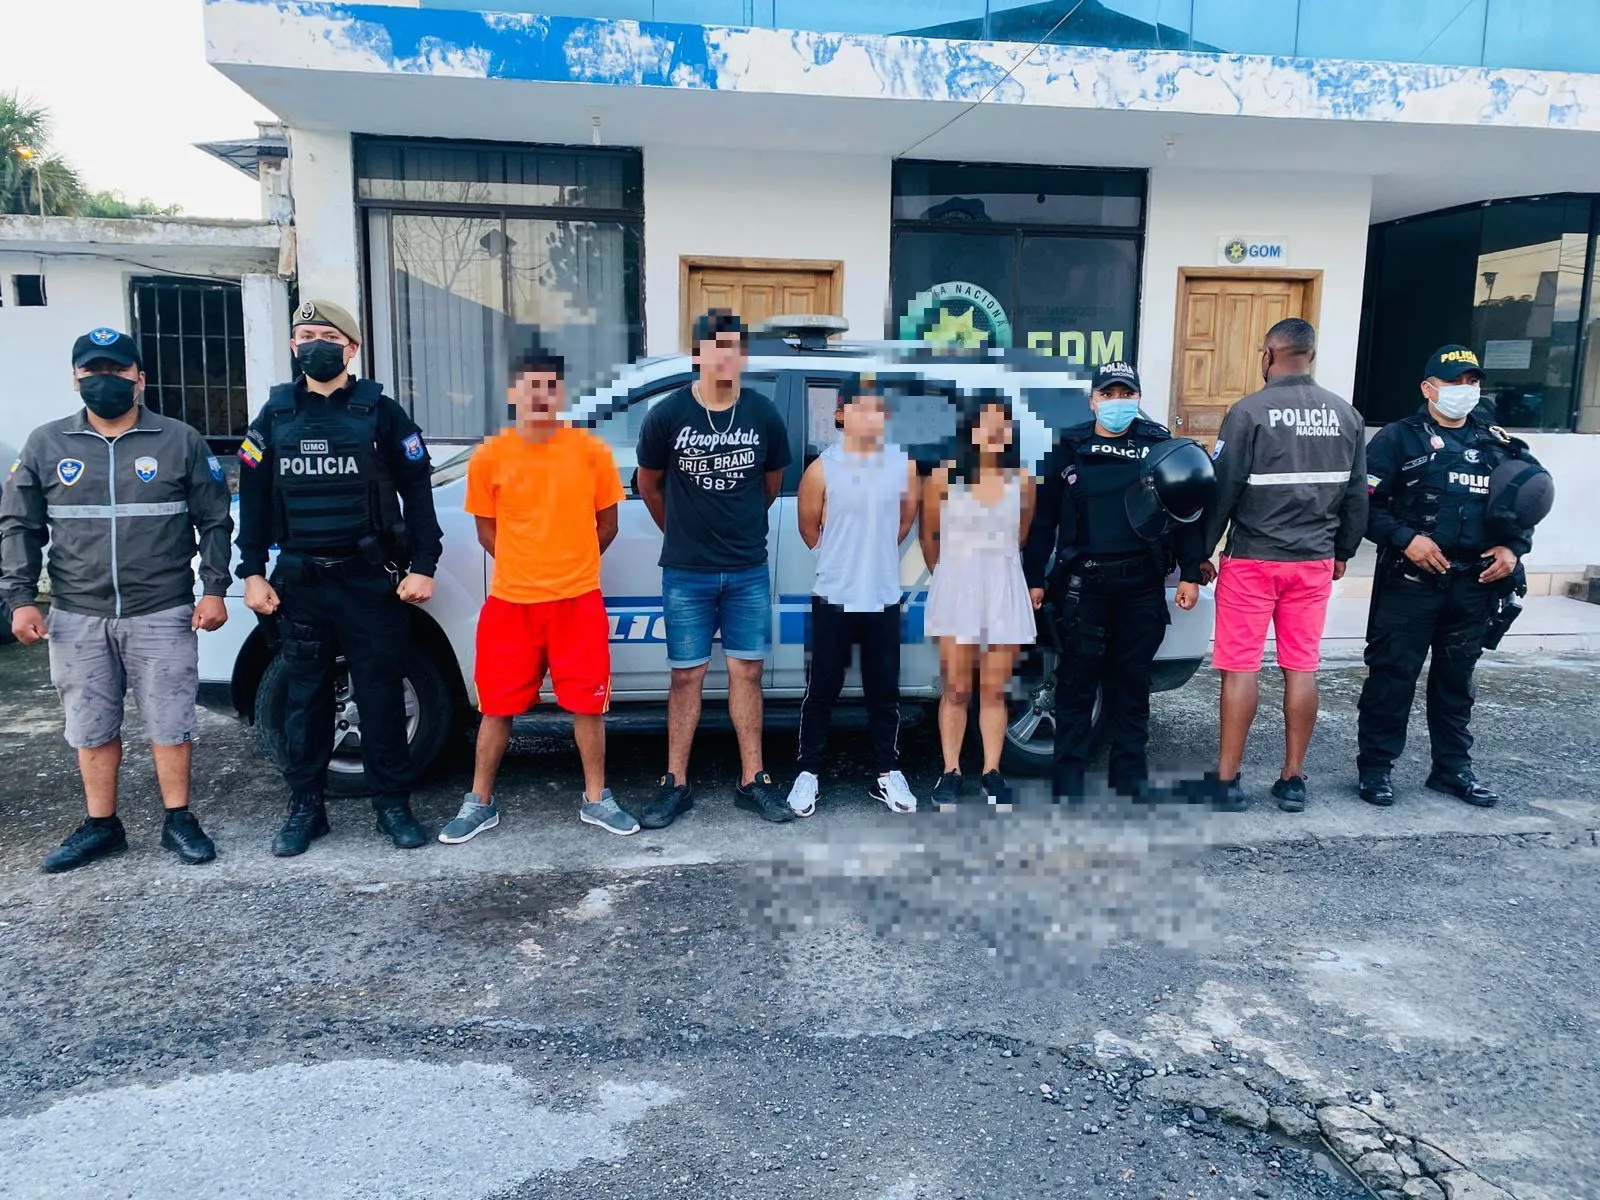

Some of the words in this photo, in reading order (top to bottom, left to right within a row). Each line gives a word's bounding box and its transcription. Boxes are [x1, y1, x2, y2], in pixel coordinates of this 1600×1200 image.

[1249, 245, 1281, 257] GOM
[1295, 426, 1341, 437] NACIONAL
[303, 443, 326, 452] UMO
[279, 456, 359, 476] POLICIA
[713, 450, 755, 470] BRAND
[694, 475, 737, 490] 1987
